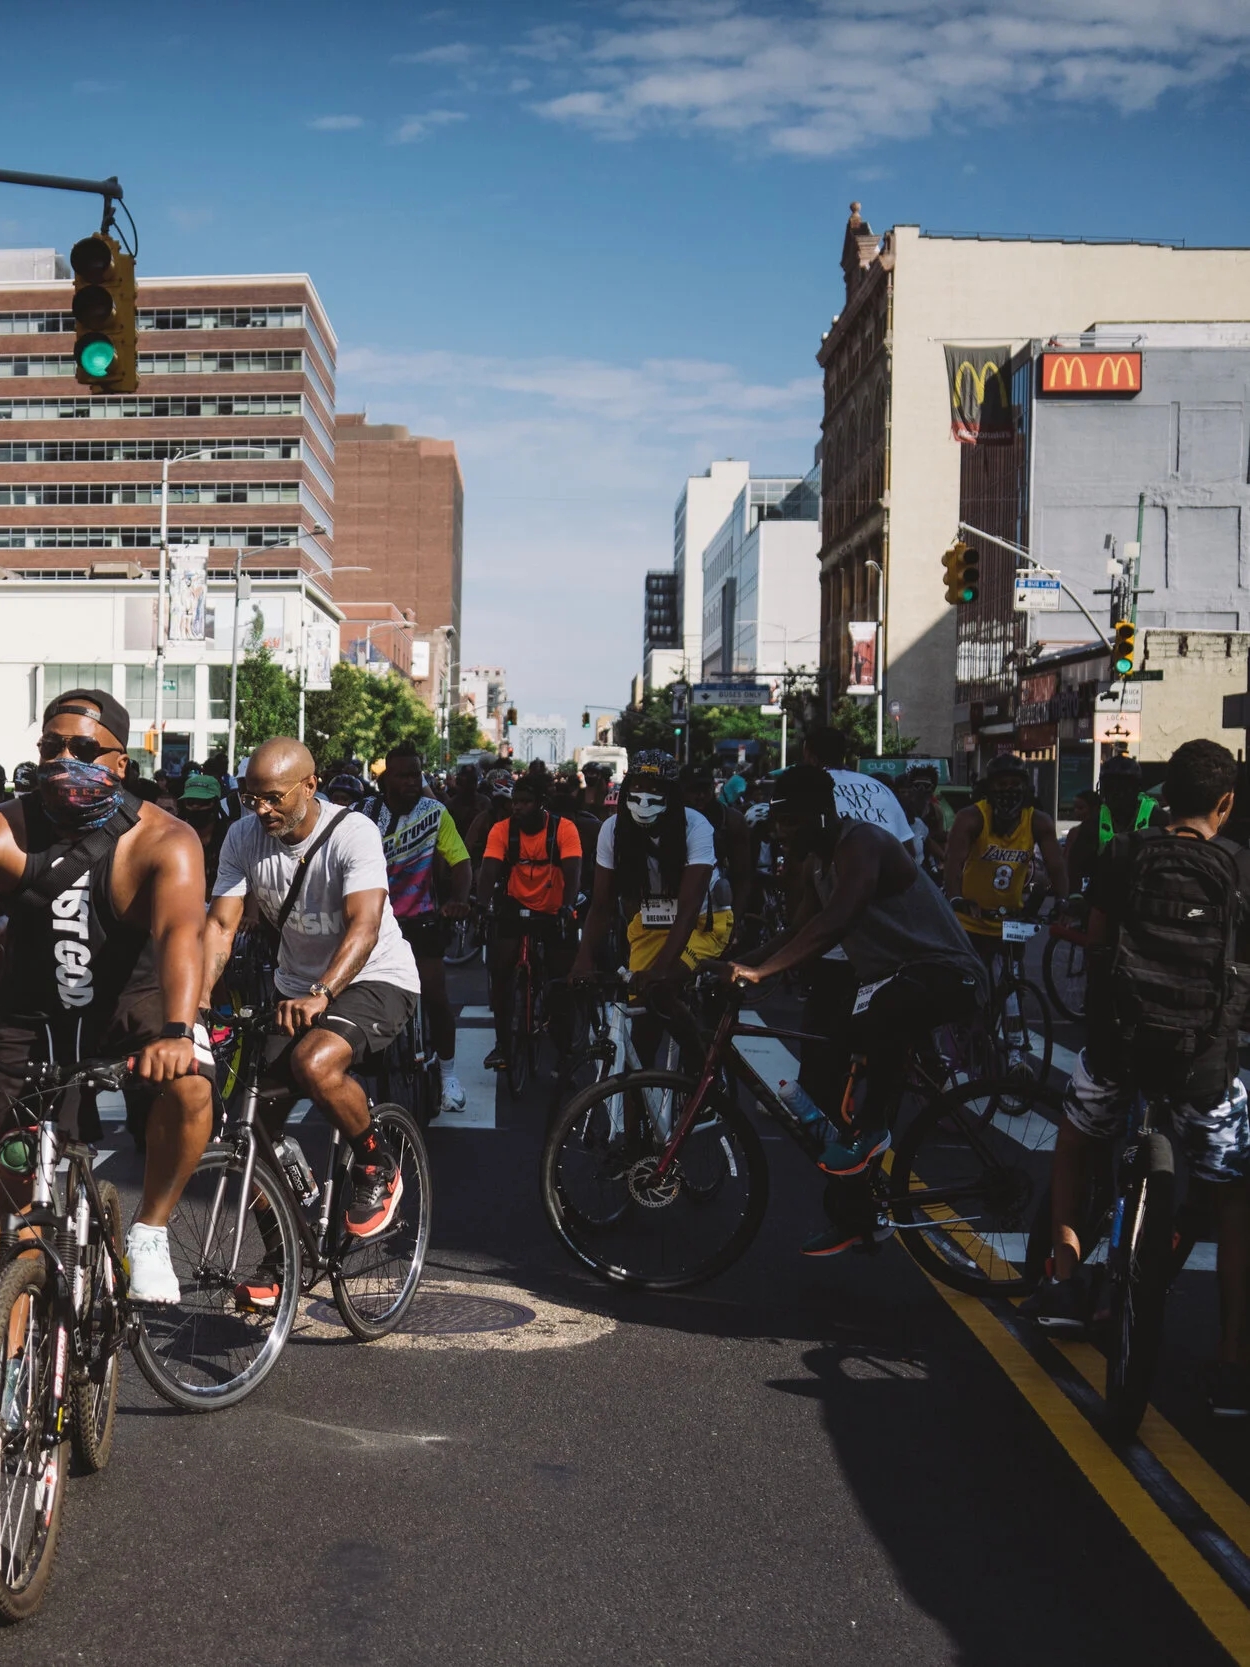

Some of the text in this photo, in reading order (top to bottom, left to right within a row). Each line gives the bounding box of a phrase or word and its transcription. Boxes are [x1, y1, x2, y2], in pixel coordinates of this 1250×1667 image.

[846, 794, 872, 809] MY
[981, 844, 1031, 863] LAKERS
[992, 864, 1012, 890] 8
